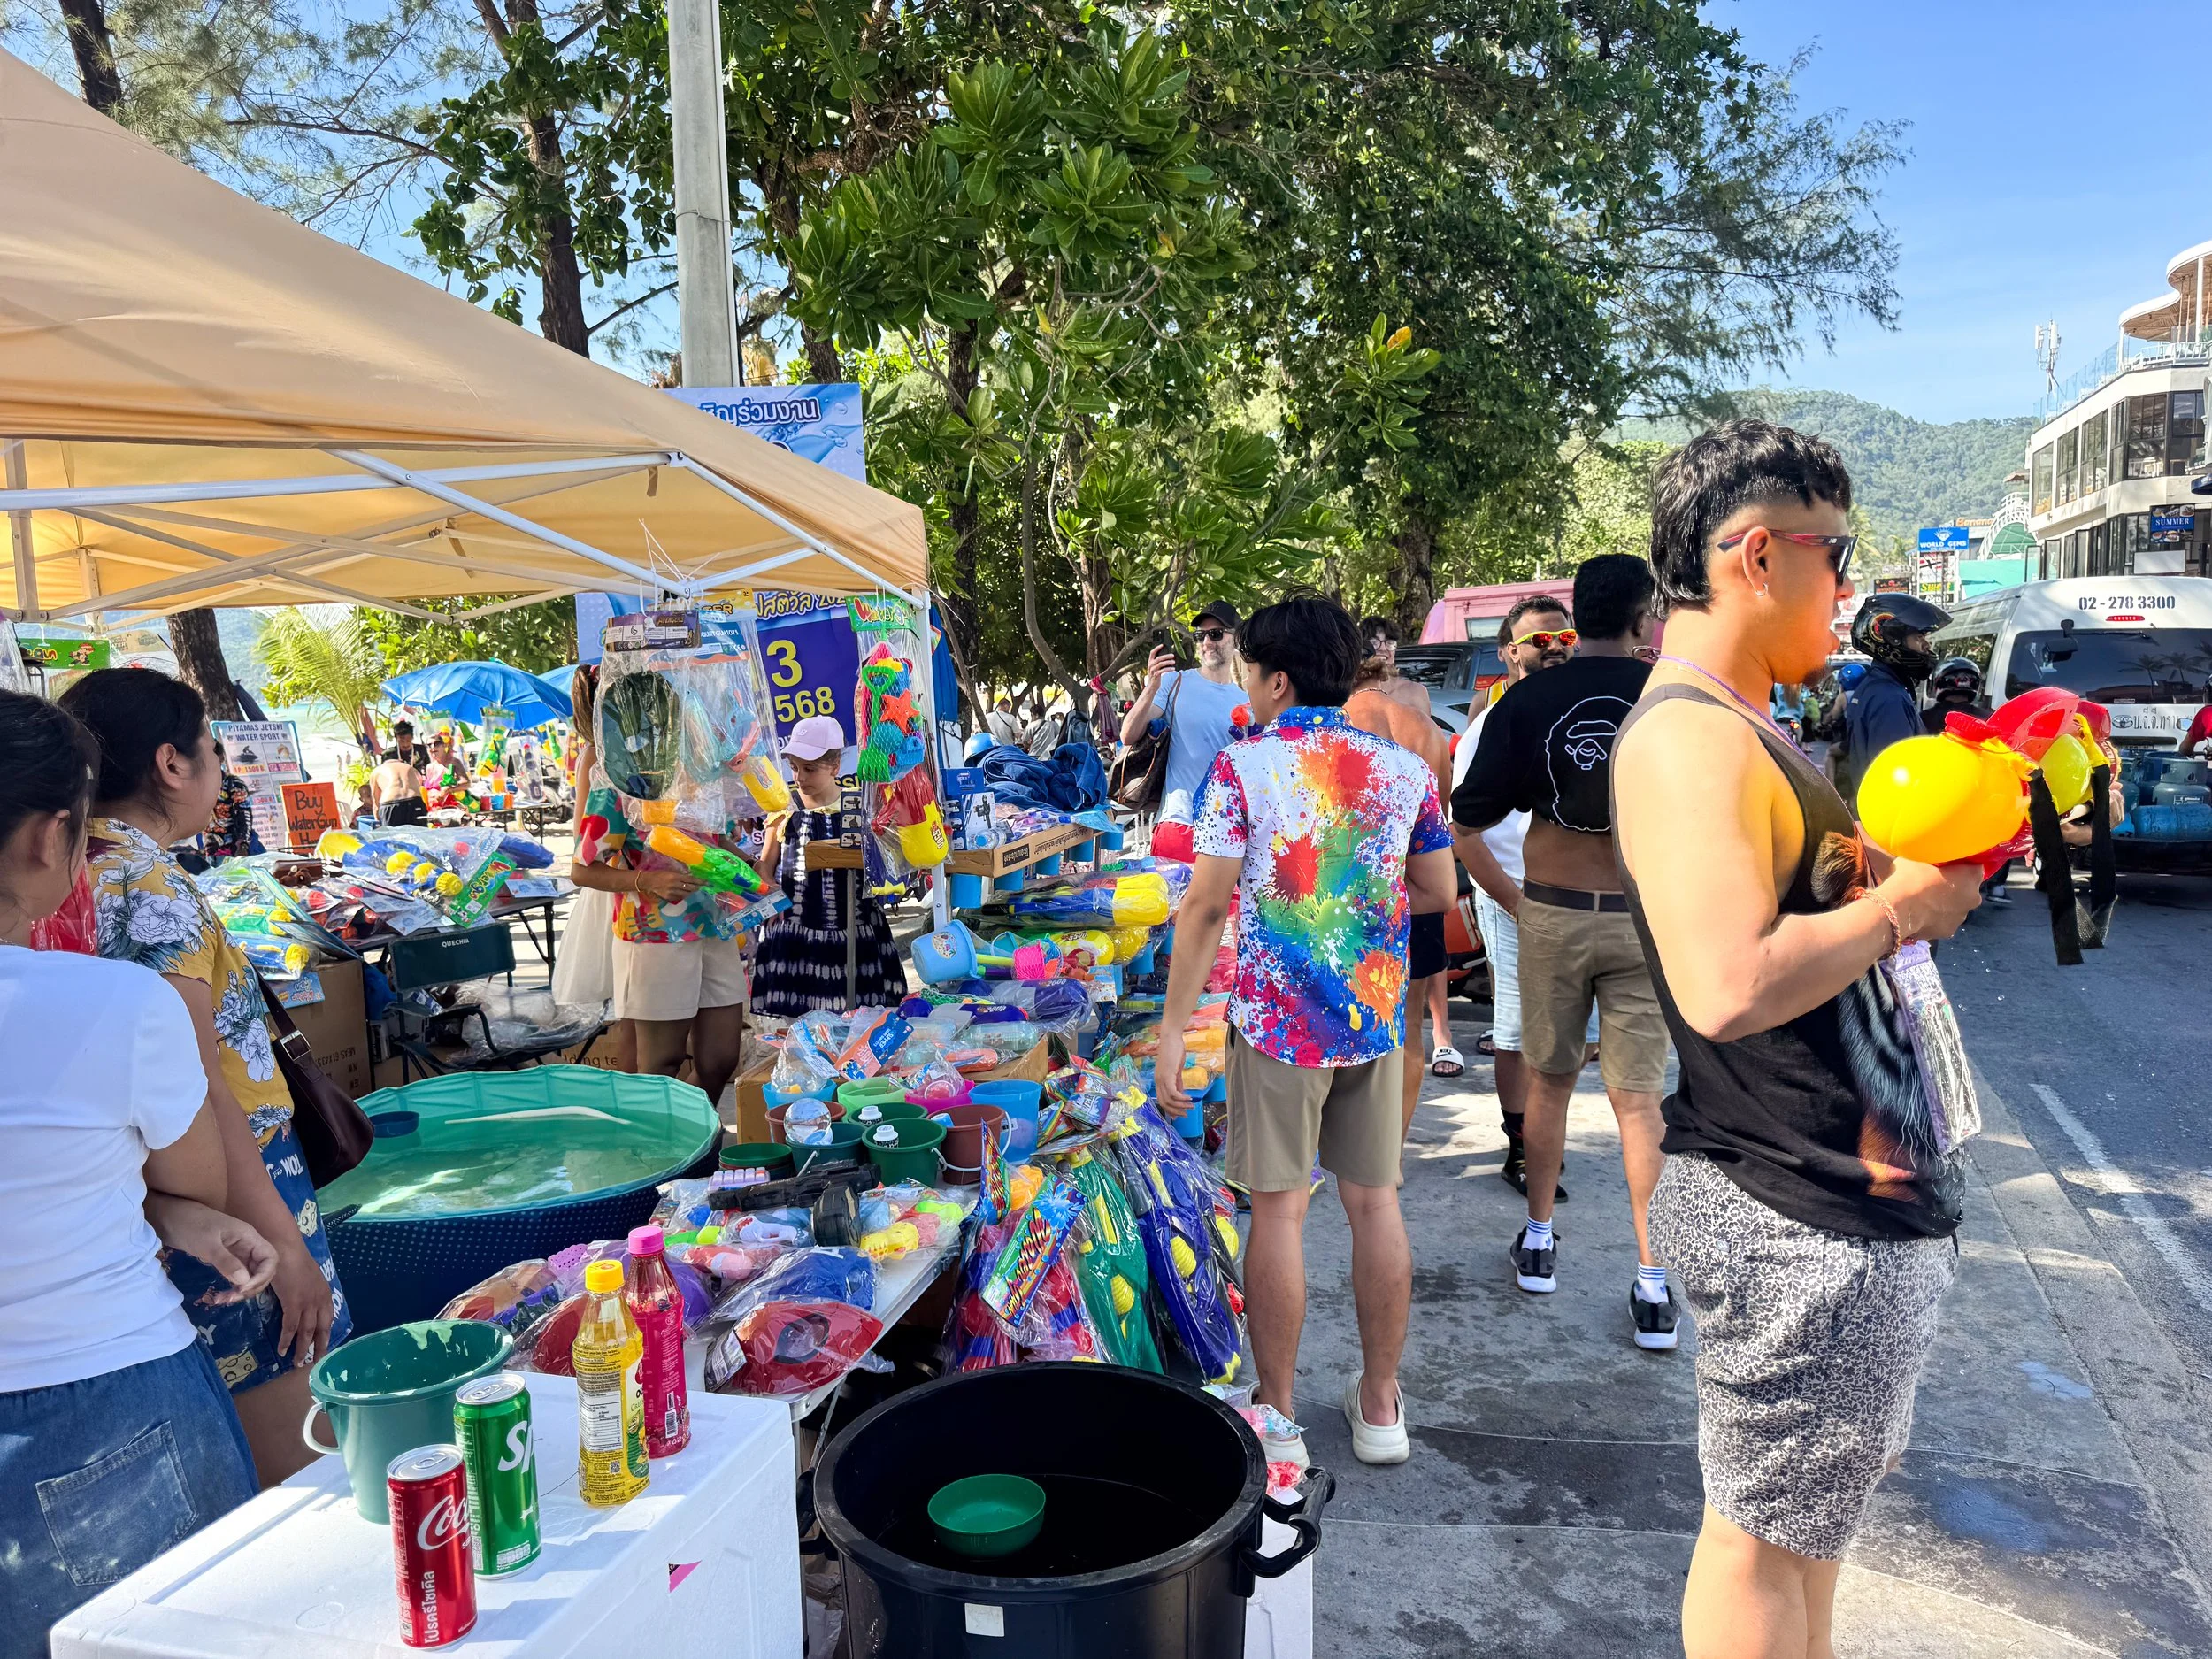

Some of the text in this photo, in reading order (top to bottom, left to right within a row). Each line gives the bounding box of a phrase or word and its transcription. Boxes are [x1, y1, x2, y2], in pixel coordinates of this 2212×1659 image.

[2079, 597, 2097, 610] 02
[2108, 596, 2133, 609] 278
[2138, 595, 2176, 609] 3300
[295, 790, 324, 815] Buy
[442, 938, 470, 948] QUECHUA
[1046, 979, 1067, 987] 2000
